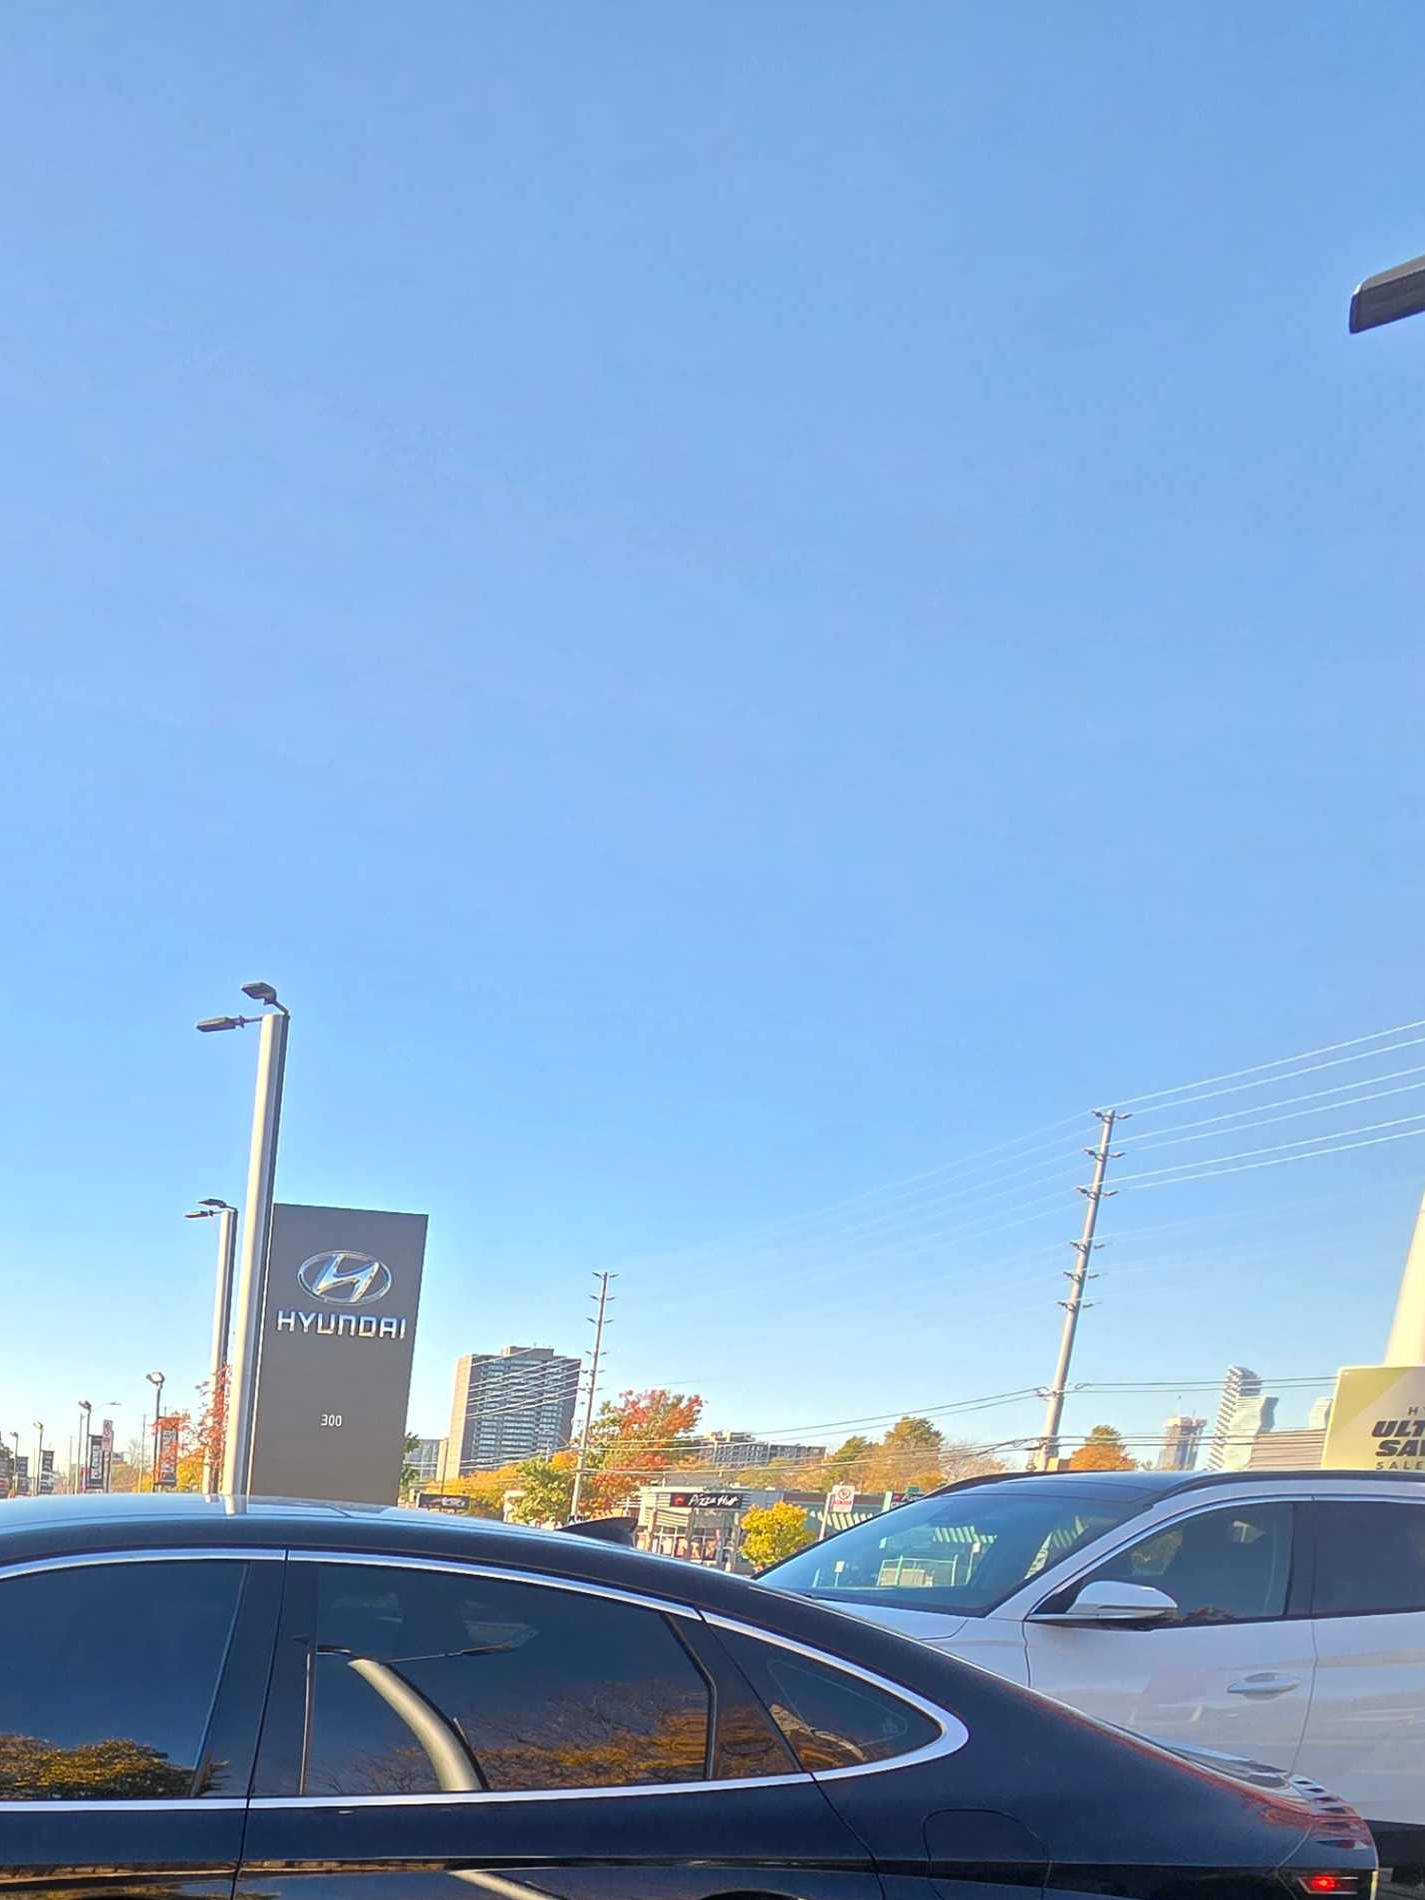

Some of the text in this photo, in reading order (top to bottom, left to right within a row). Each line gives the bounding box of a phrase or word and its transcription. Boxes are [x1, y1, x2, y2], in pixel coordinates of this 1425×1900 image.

[277, 1310, 406, 1340] HYUNDAI
[1407, 1406, 1425, 1416] H
[321, 1414, 343, 1428] 300
[1375, 1439, 1425, 1457] SA
[688, 1494, 739, 1507] Pizza Hut
